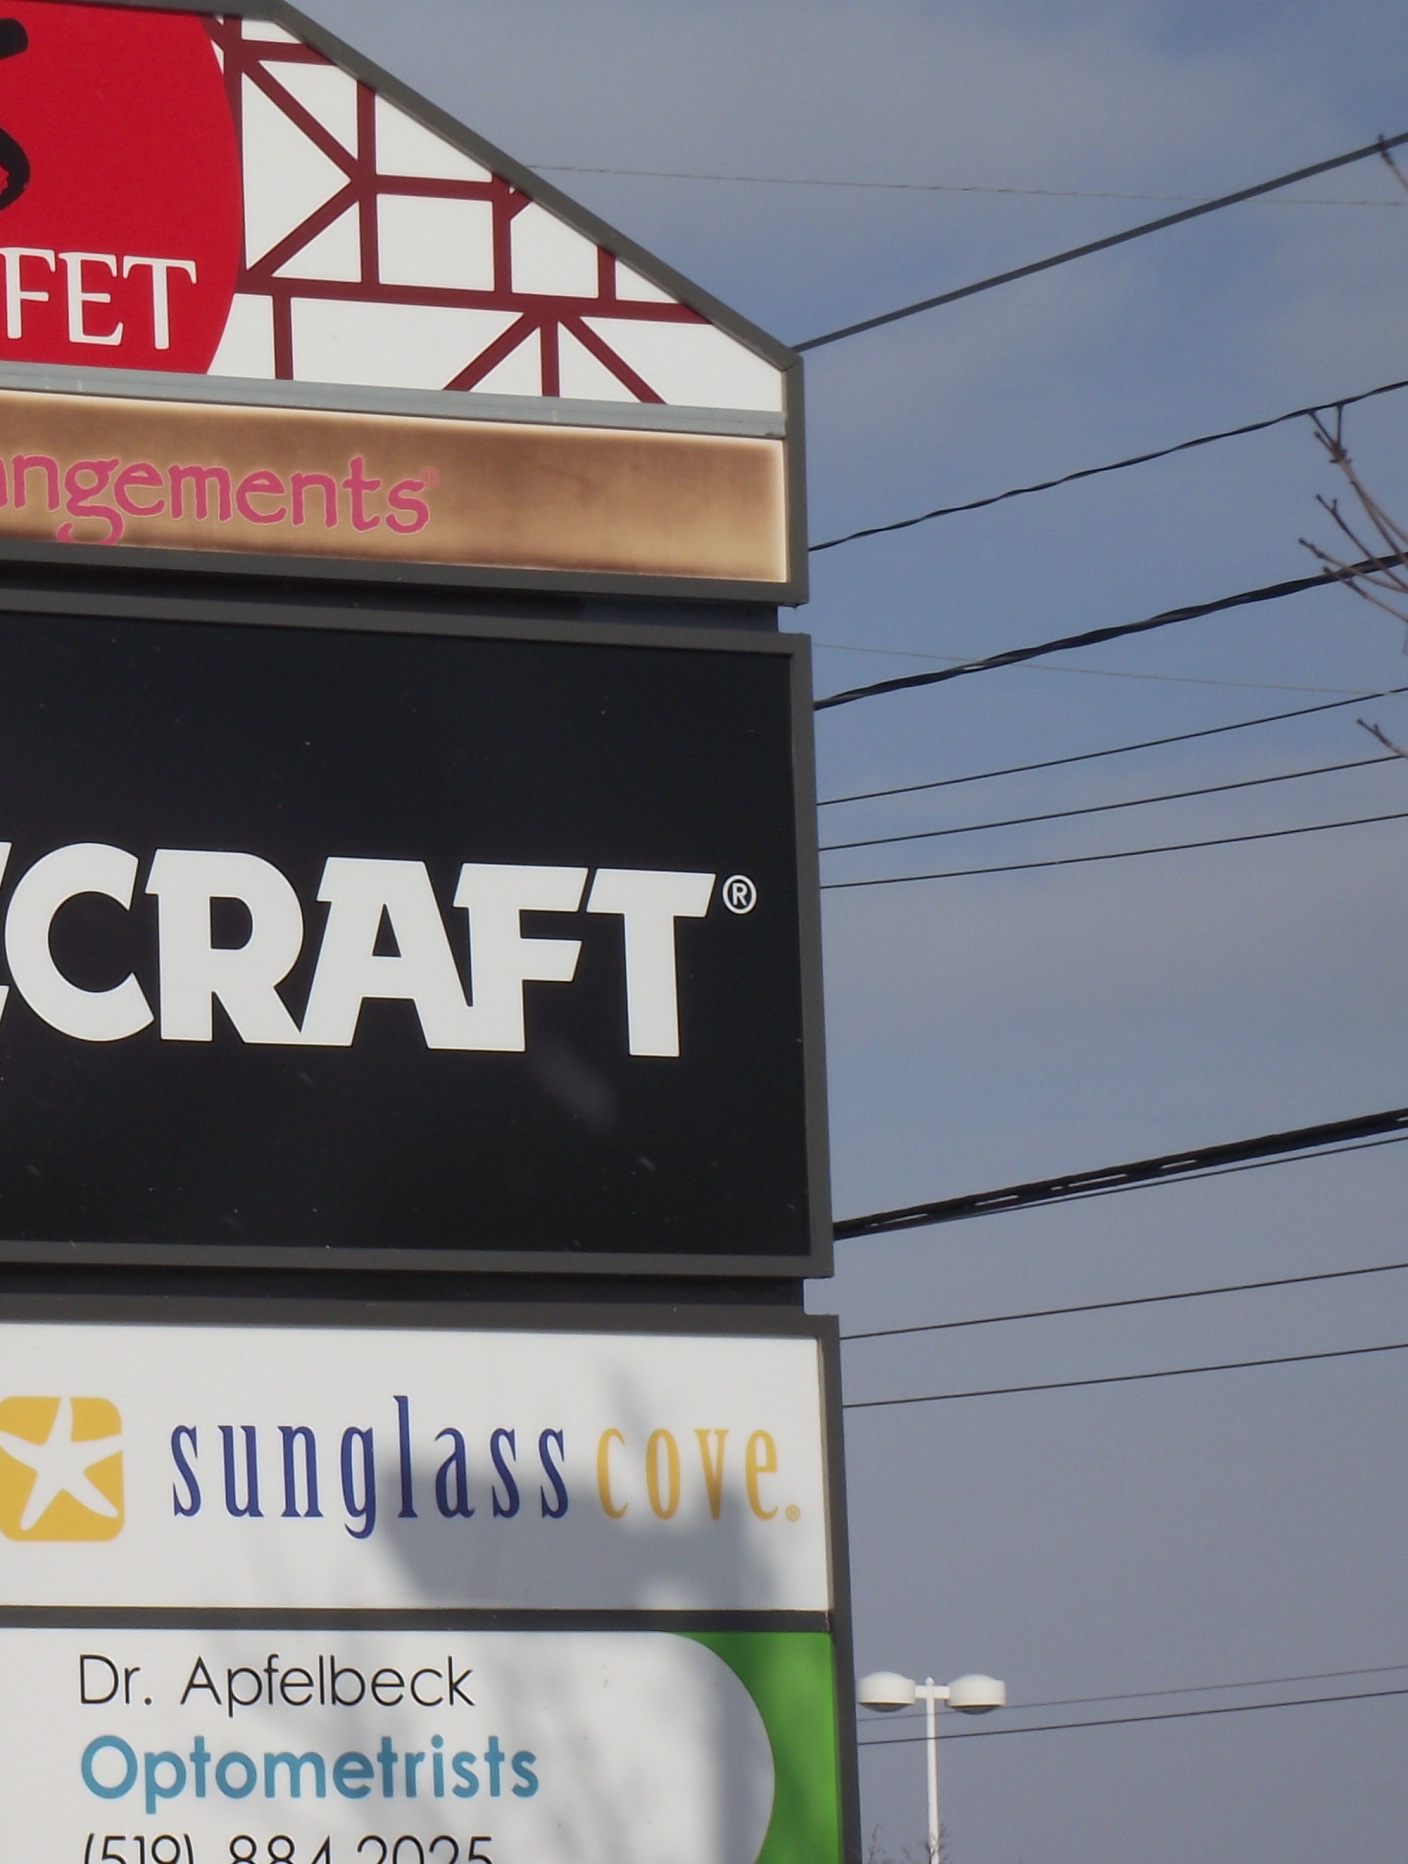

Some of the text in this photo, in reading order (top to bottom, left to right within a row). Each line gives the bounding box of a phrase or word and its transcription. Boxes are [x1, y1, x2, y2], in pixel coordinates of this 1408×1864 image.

[170, 1395, 569, 1539] sunglass
[78, 1654, 474, 1718] Dr. Apfelbeck
[80, 1734, 539, 1814] Optometrists
